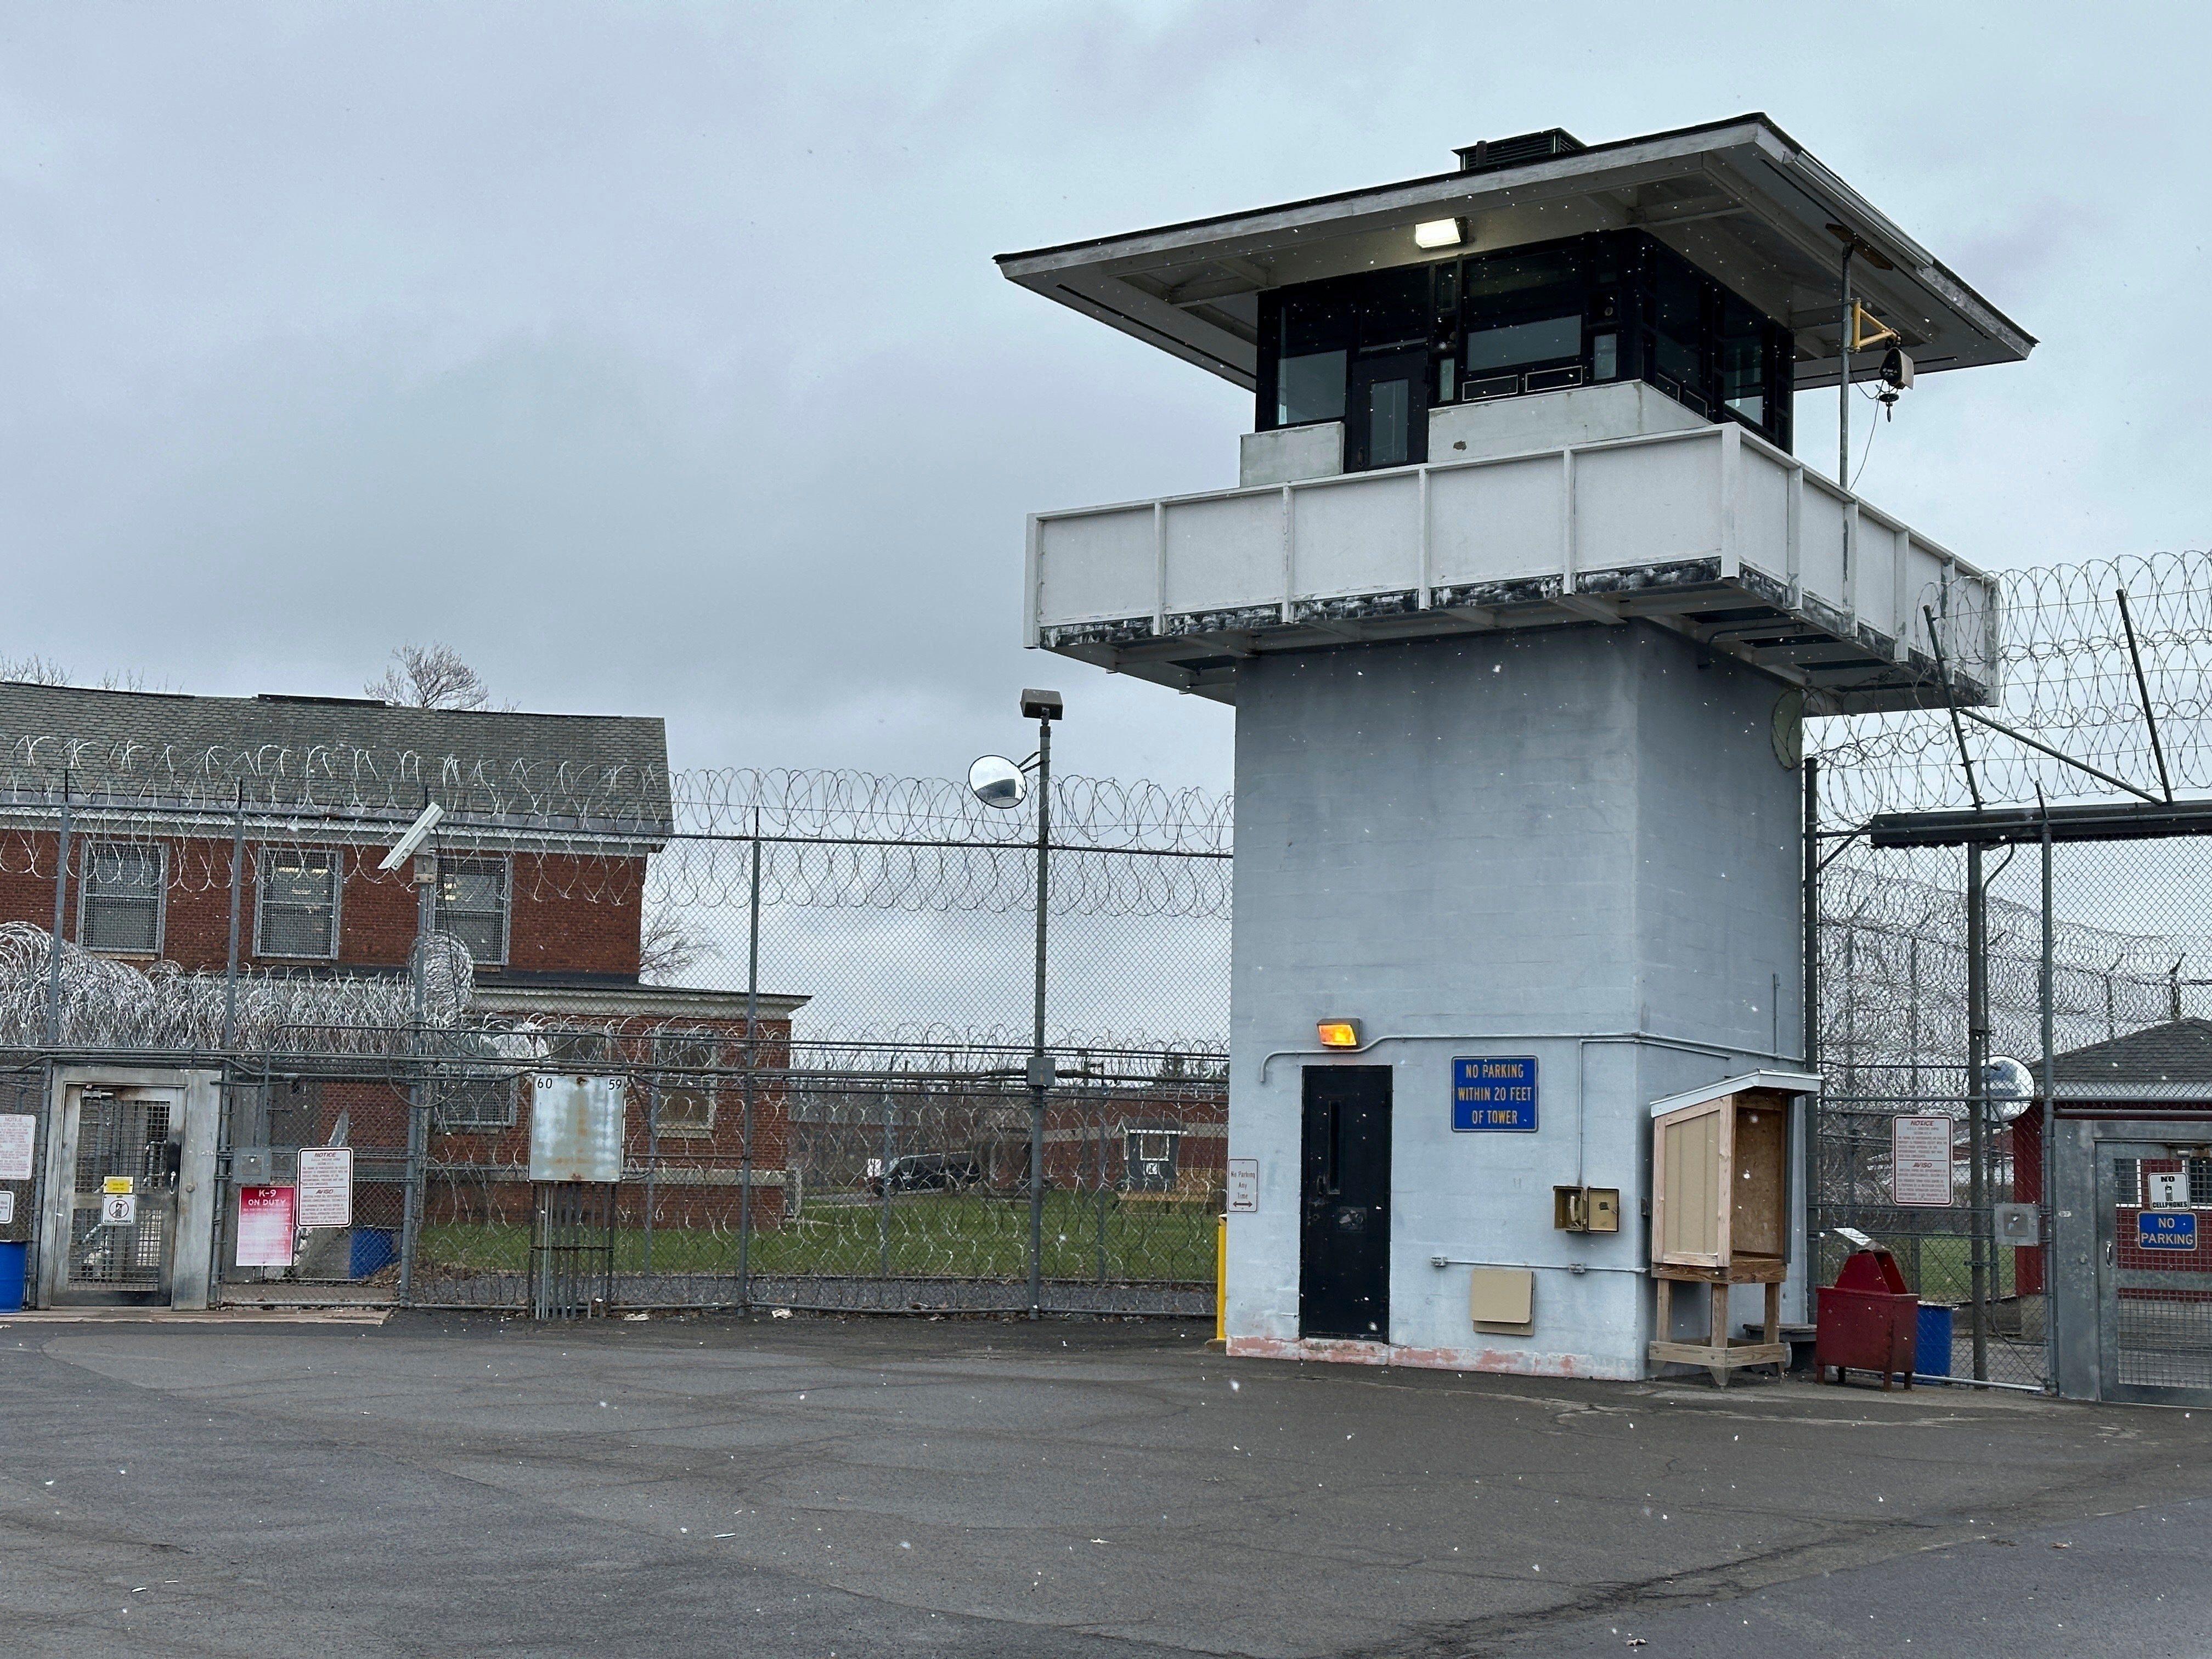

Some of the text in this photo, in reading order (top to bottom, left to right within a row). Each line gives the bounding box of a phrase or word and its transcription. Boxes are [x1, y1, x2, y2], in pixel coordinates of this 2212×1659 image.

[1466, 1064, 1524, 1078] NO PARKING
[537, 1077, 552, 1089] 60
[608, 1079, 622, 1090] 59
[1458, 1087, 1532, 1101] WITHIN 20 FEET
[1472, 1110, 1518, 1124] OF TOWER
[1238, 1170, 1255, 1180] Parking
[1238, 1182, 1248, 1190] Any
[2158, 1217, 2175, 1229] NO
[2141, 1233, 2193, 1245] PARKING
